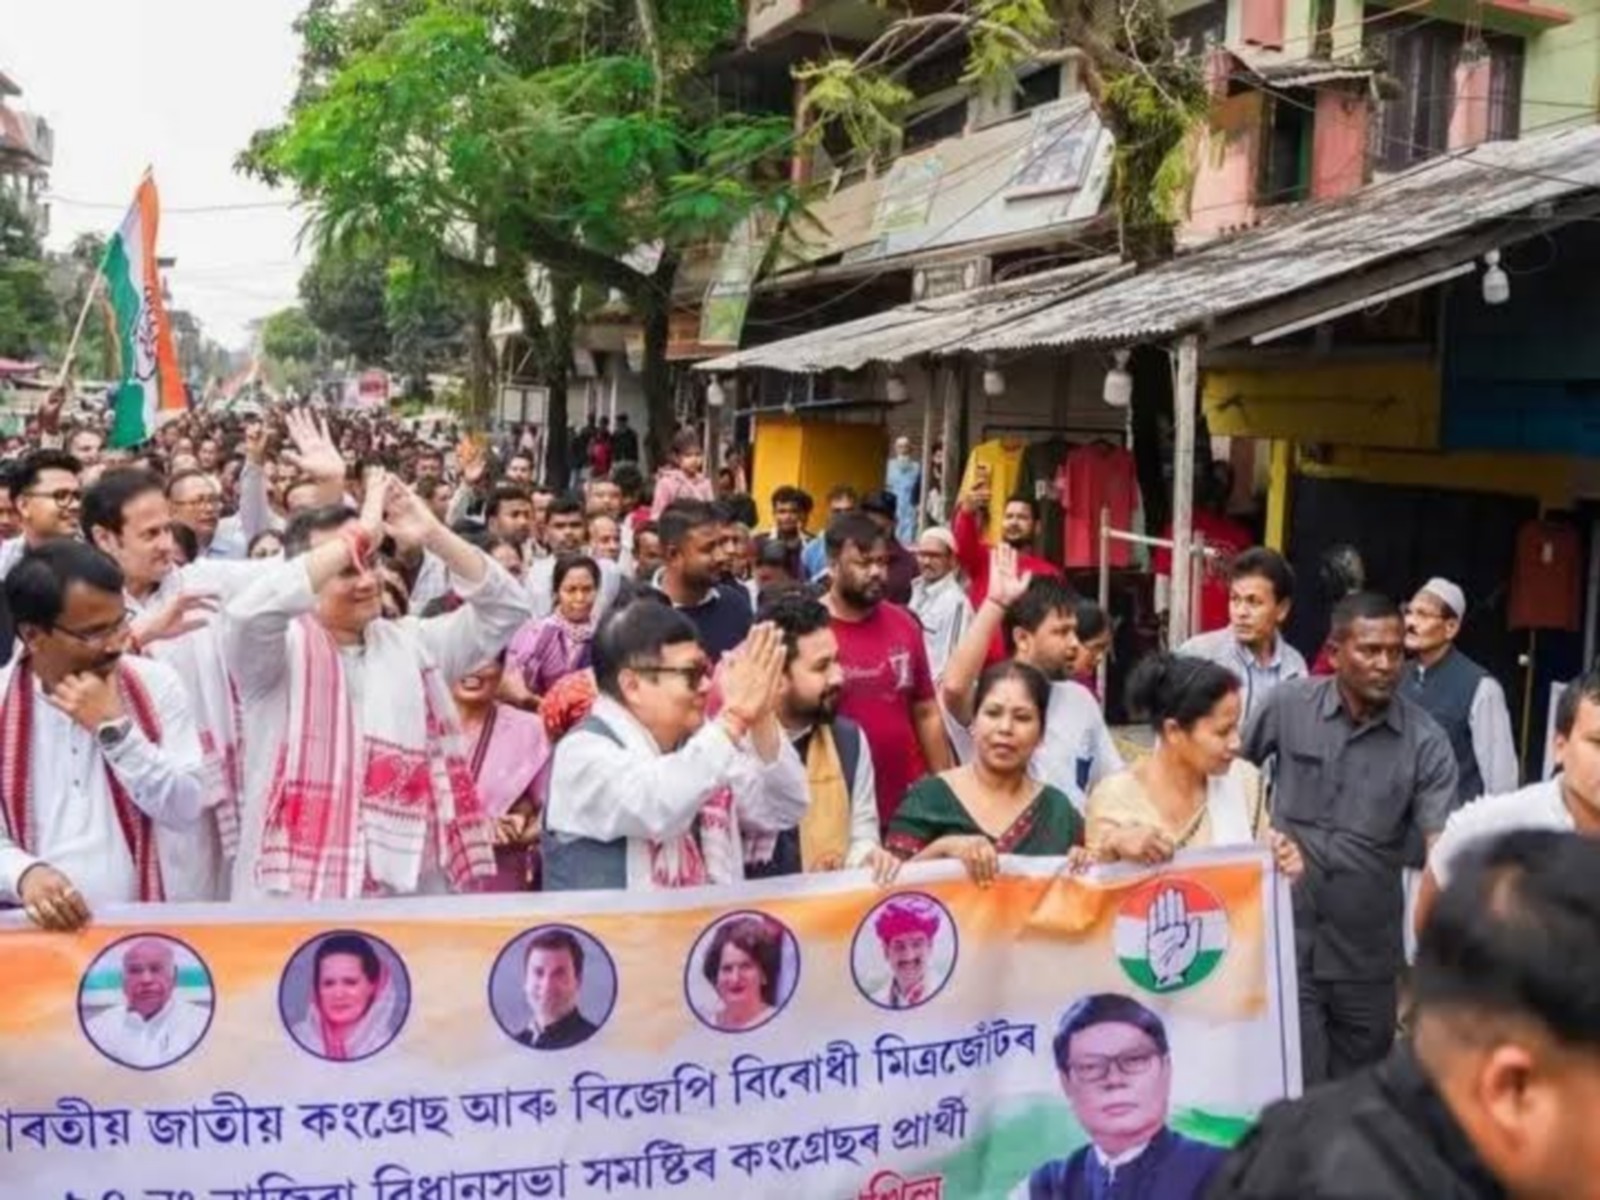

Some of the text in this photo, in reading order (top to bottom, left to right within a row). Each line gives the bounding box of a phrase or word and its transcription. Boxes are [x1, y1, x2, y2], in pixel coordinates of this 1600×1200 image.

[0, 1097, 131, 1151] াৰতীয়
[145, 1091, 284, 1148] জাতীয়
[458, 1088, 557, 1128] আৰু
[570, 1063, 718, 1122] বিজেপি
[729, 1040, 859, 1106] বিৰোধী
[581, 1140, 718, 1193] সমষ্টিৰ
